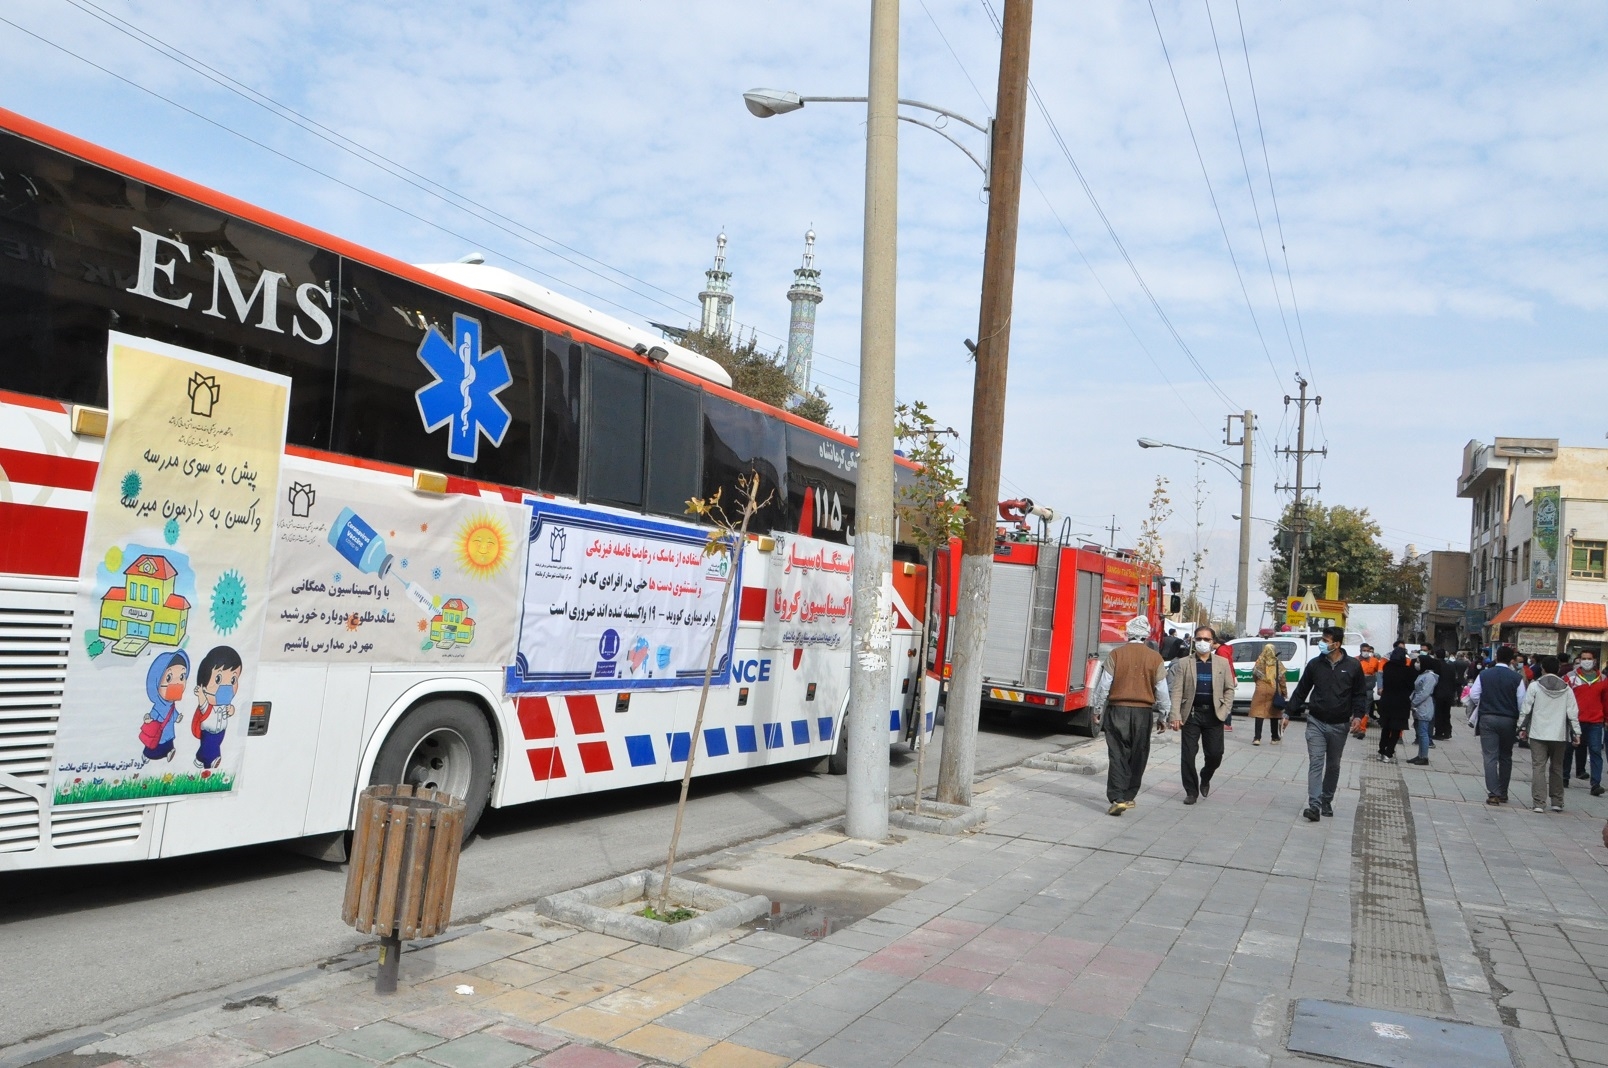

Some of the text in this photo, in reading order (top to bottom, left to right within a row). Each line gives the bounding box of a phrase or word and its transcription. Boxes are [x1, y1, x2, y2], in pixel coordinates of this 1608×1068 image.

[126, 225, 334, 345] EMS
[819, 441, 846, 469] کرمانشاه
[143, 448, 257, 492] پیش به سوی مدرسه
[120, 493, 157, 517] میرسه
[815, 486, 842, 532] ۱۱۵
[209, 506, 221, 529] به
[225, 498, 261, 532] واکسن
[346, 530, 364, 547] Vaccine
[347, 521, 371, 543] Coronavirus
[585, 538, 612, 558] فیزیکی
[612, 541, 631, 557] فاصله
[632, 546, 652, 564] رعایت
[656, 548, 675, 563] ماسک
[675, 551, 682, 567] از
[682, 552, 702, 566] استفاده
[784, 542, 815, 576] سیار
[578, 572, 588, 588] در
[588, 571, 599, 585] که
[599, 572, 623, 591] افرادی
[623, 577, 633, 592] در
[633, 577, 648, 593] حتی
[648, 577, 656, 590] ها
[656, 579, 672, 592] دست
[291, 579, 390, 600] با واکسیناسیون همگانی
[549, 600, 568, 616] است
[568, 602, 596, 622] ضروری
[596, 602, 608, 618] اند
[608, 604, 622, 619] شده
[774, 587, 801, 622] کرونا
[280, 607, 318, 624] خورشید
[320, 609, 349, 626] دوباره
[374, 612, 396, 624] شاهد
[623, 605, 647, 624] واکسینه
[666, 608, 683, 625] کووید
[684, 610, 702, 627] بیماری
[283, 636, 374, 654] مهر در مدارس باشیم
